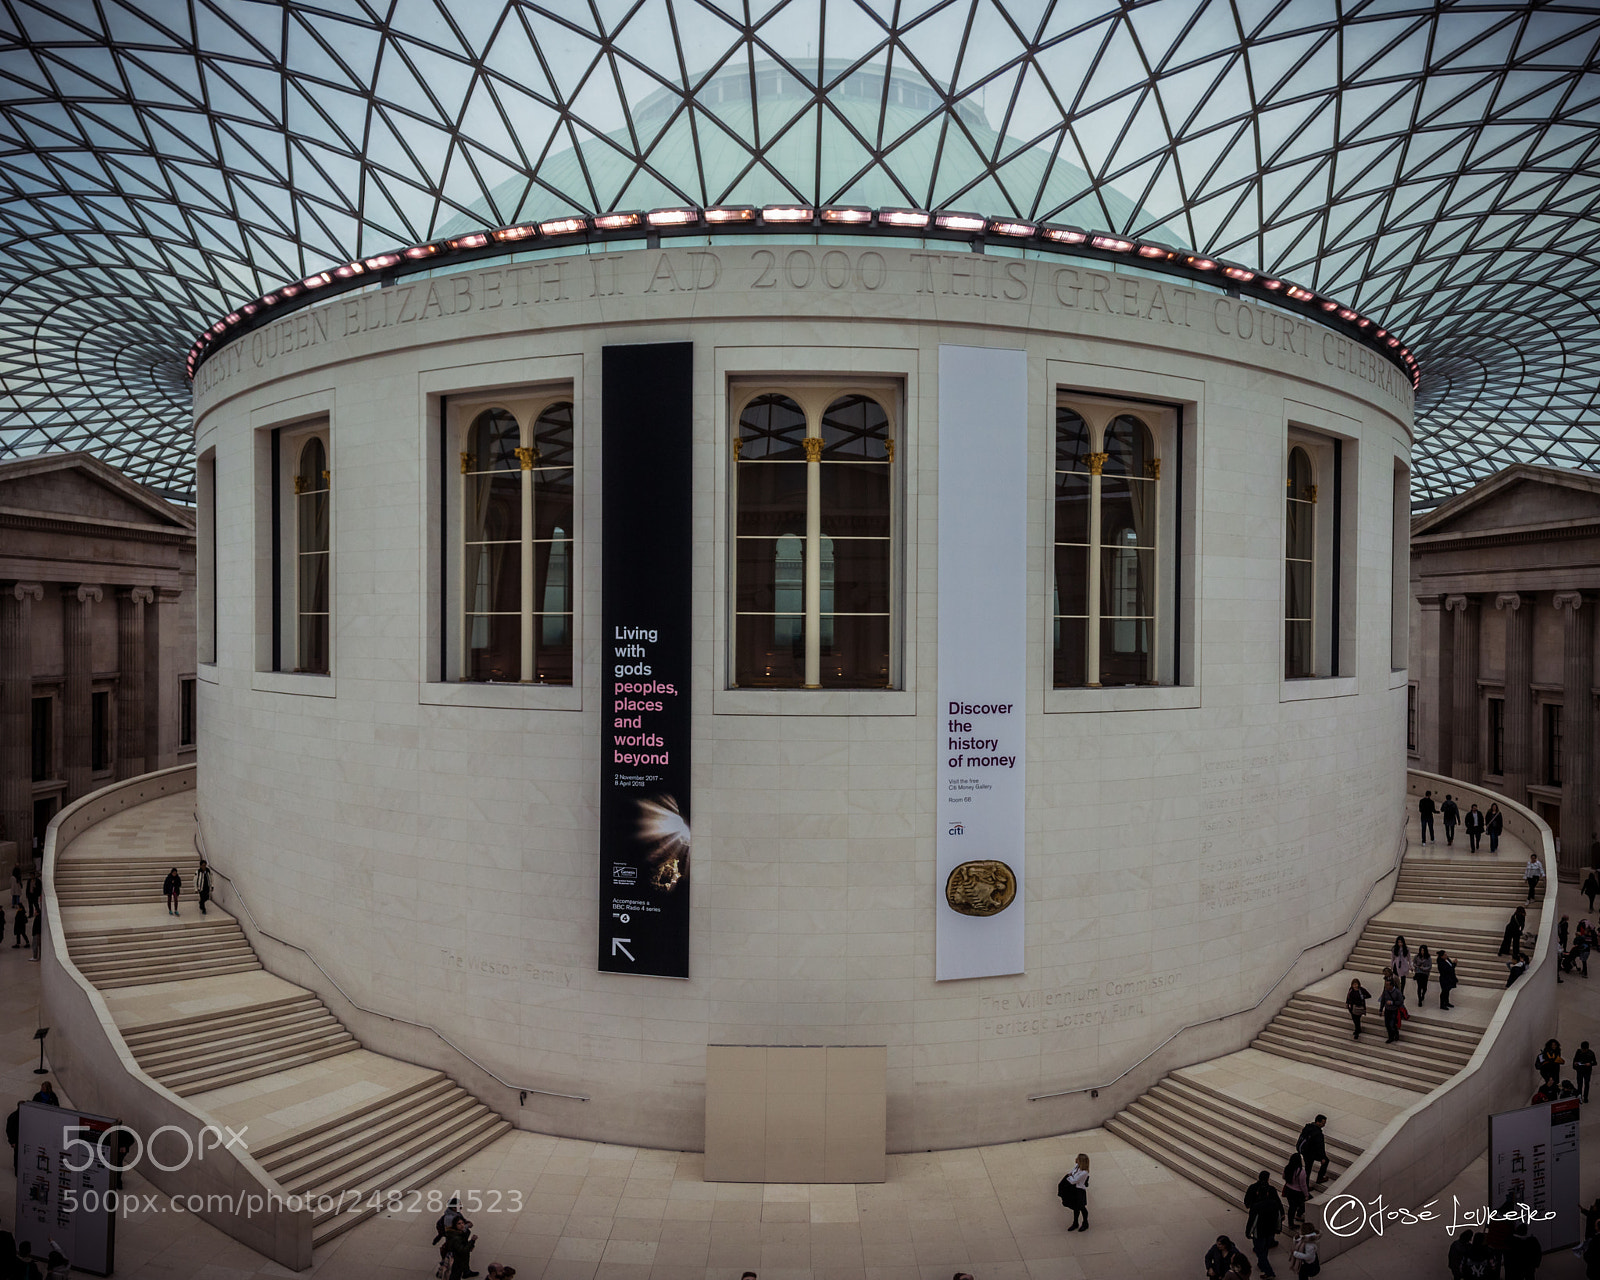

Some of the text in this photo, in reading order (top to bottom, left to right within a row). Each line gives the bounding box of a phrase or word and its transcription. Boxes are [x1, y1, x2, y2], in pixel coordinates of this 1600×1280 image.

[252, 306, 331, 368] QUEEN
[342, 260, 569, 336] ELIZABETH
[588, 255, 624, 298] II
[644, 249, 723, 294] AD
[750, 247, 888, 291] 2000
[909, 251, 1029, 302] THIS
[1054, 267, 1201, 328] GREAT
[1212, 295, 1317, 358] COURT
[615, 626, 658, 643] Living
[614, 644, 646, 658] with
[614, 662, 652, 678] gods
[614, 680, 678, 696] peoples,
[614, 697, 663, 713] places
[948, 702, 1013, 715] Discover
[613, 715, 642, 729] and
[948, 719, 972, 733] the
[613, 733, 664, 747] worlds
[948, 737, 999, 752] history
[613, 750, 669, 767] beyond
[948, 754, 1016, 769] of money
[948, 825, 964, 835] citi
[1105, 971, 1184, 997] Commission
